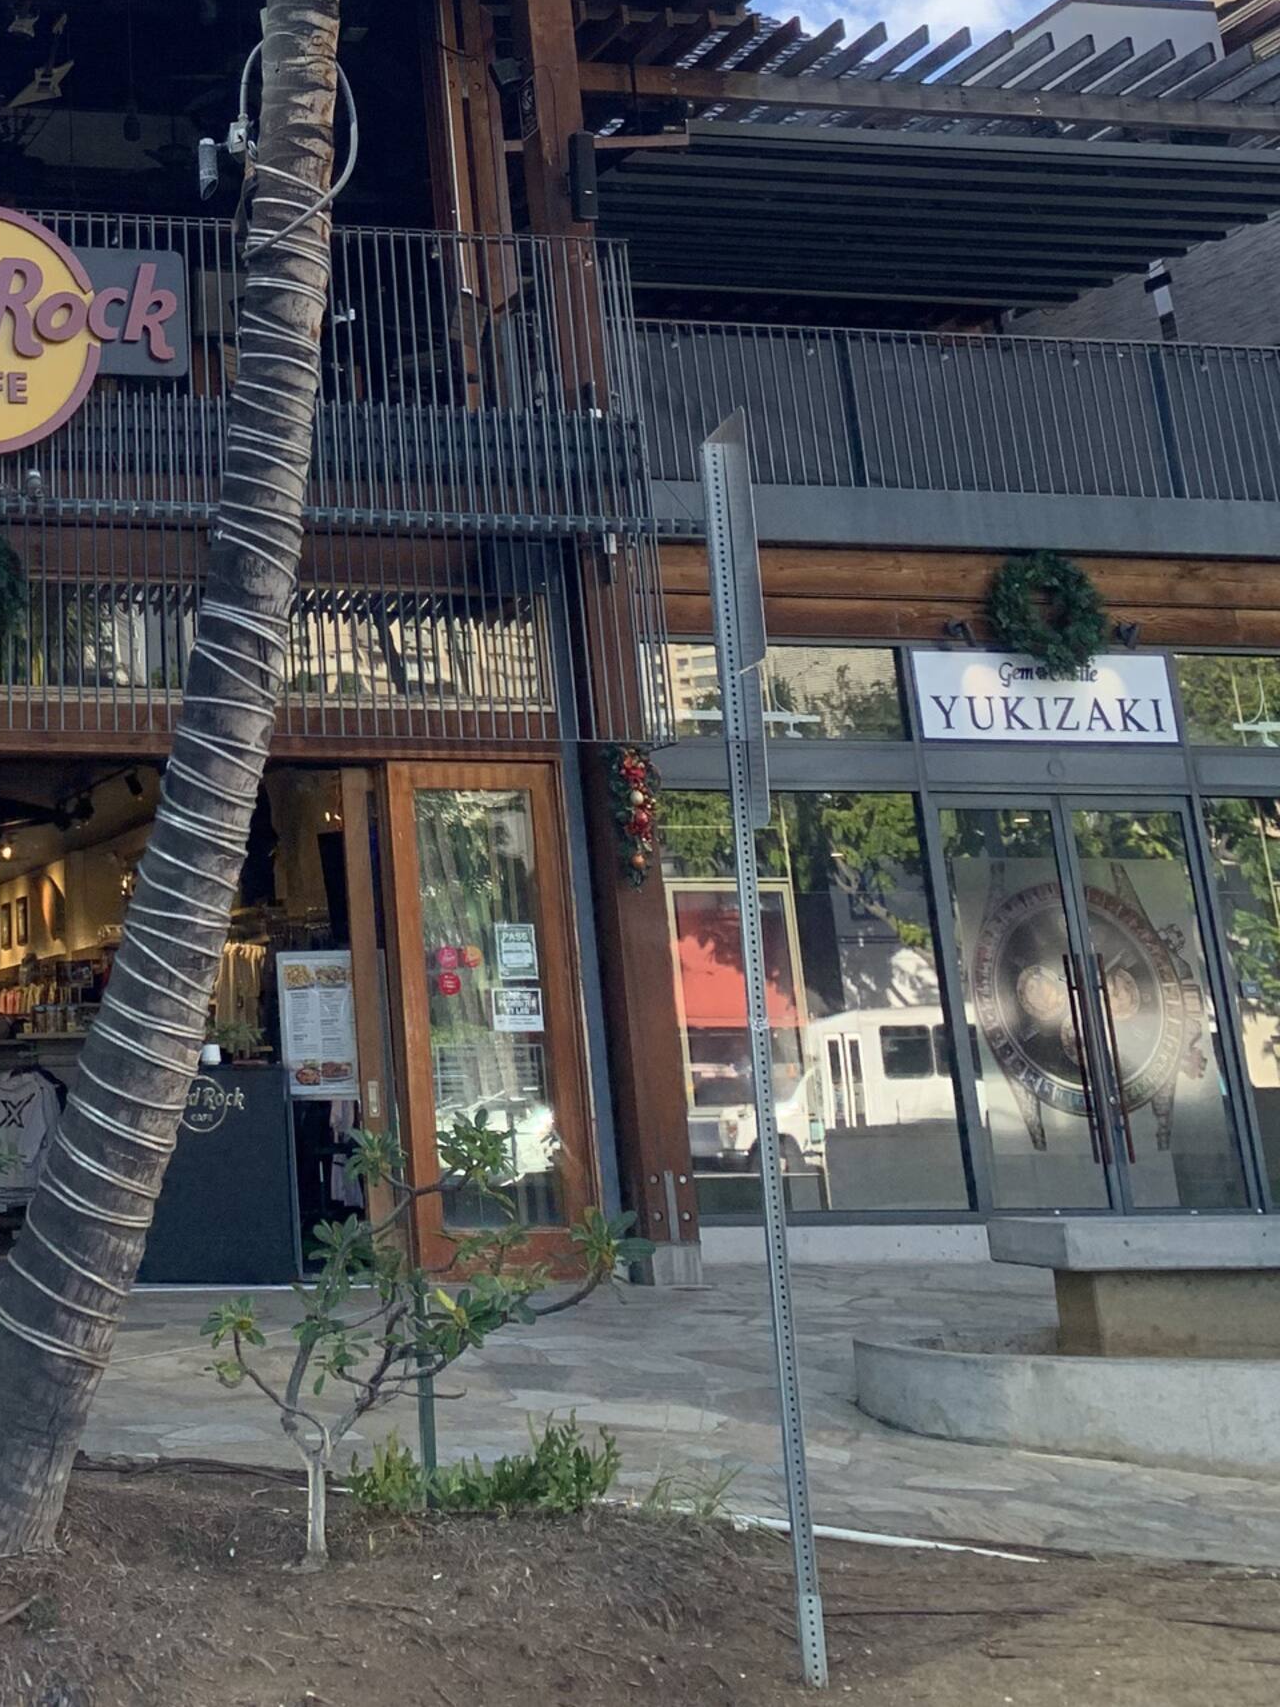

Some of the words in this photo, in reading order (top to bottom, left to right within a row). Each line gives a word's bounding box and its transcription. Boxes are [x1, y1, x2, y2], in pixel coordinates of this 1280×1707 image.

[998, 662, 1034, 687] Gem
[930, 695, 1167, 733] YUKIZAKI
[502, 931, 529, 942] PASS
[202, 1086, 245, 1110] Rock
